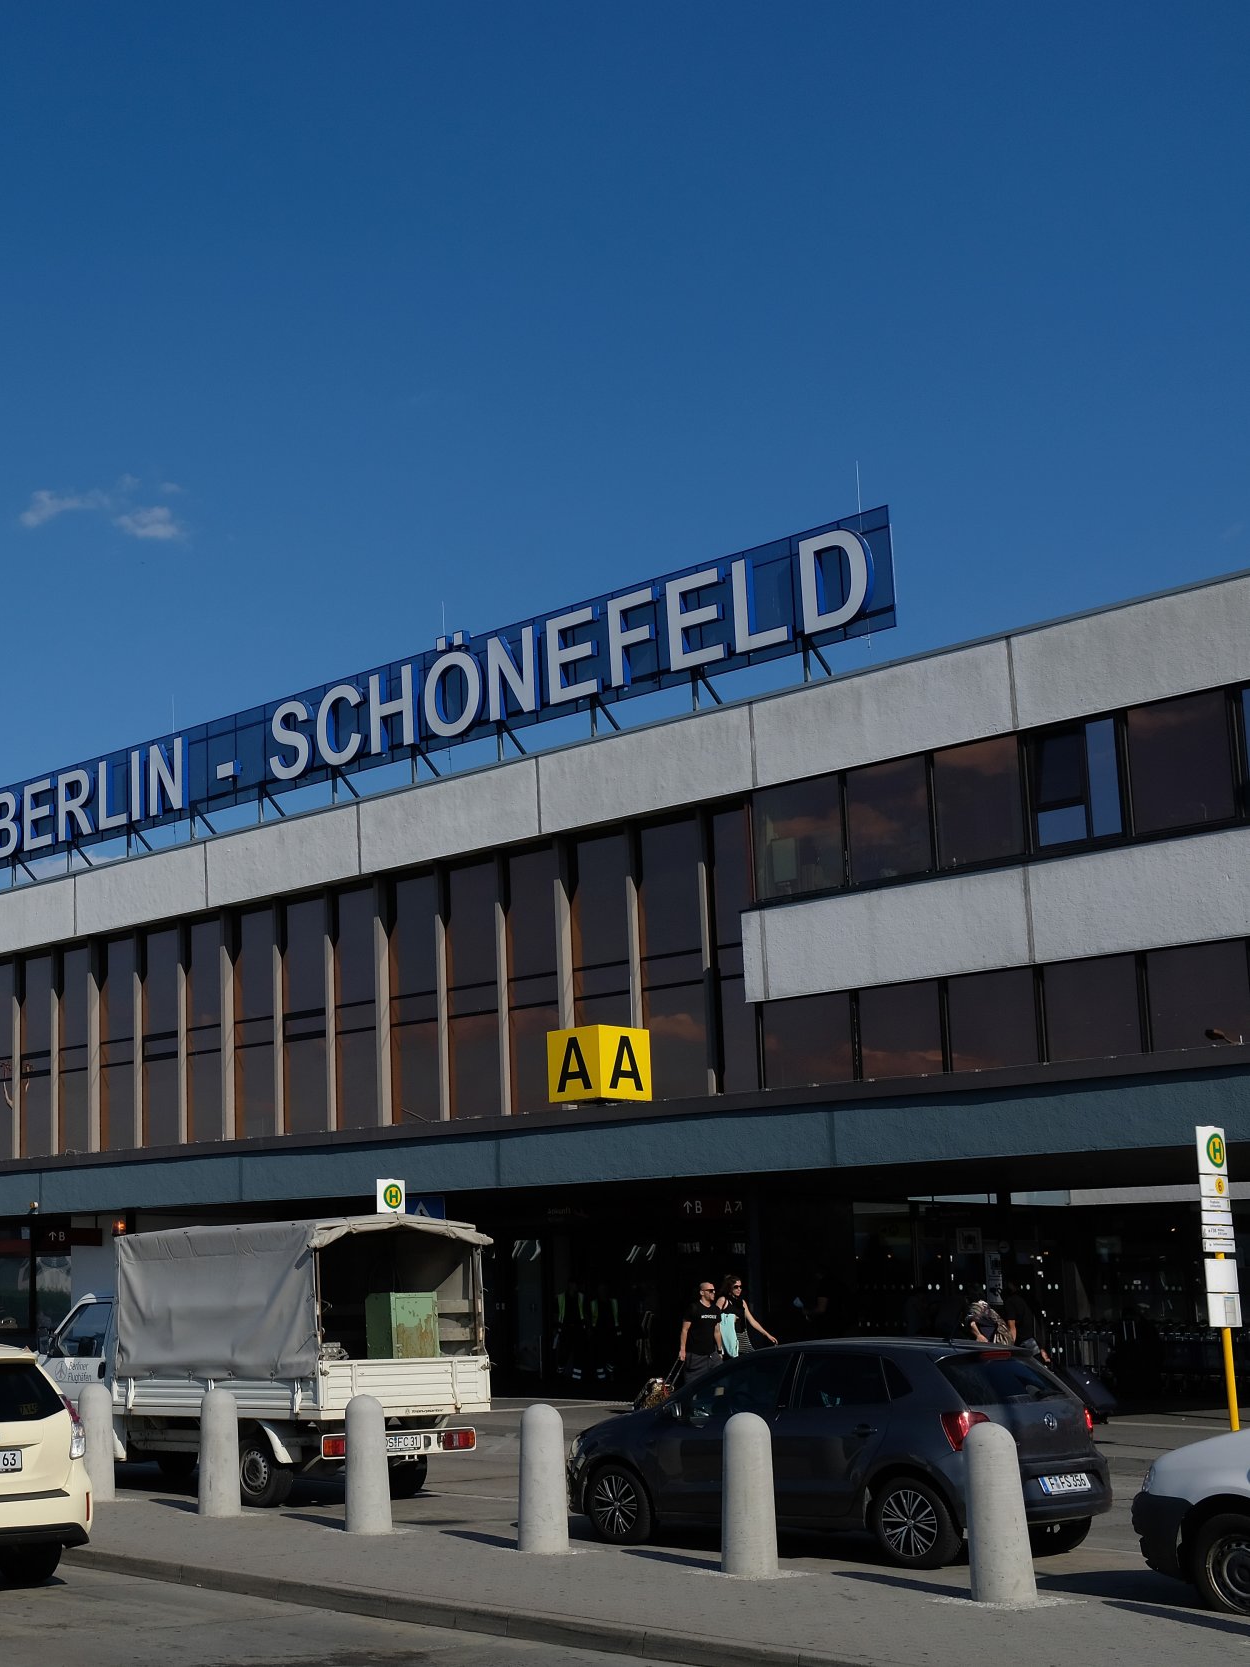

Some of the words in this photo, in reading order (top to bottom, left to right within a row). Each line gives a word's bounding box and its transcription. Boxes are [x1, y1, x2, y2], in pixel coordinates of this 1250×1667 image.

[269, 528, 874, 782] SCHÖNEFELD
[556, 1036, 593, 1094] A
[610, 1035, 644, 1092] A
[1212, 1141, 1223, 1161] H
[388, 1190, 399, 1204] H
[695, 1200, 703, 1214] B
[724, 1200, 733, 1214] A
[58, 1231, 66, 1242] B
[68, 1361, 89, 1371] Berliner
[397, 1436, 409, 1447] FC
[410, 1436, 418, 1447] 31
[2, 1452, 17, 1467] 63
[1048, 1476, 1055, 1489] F
